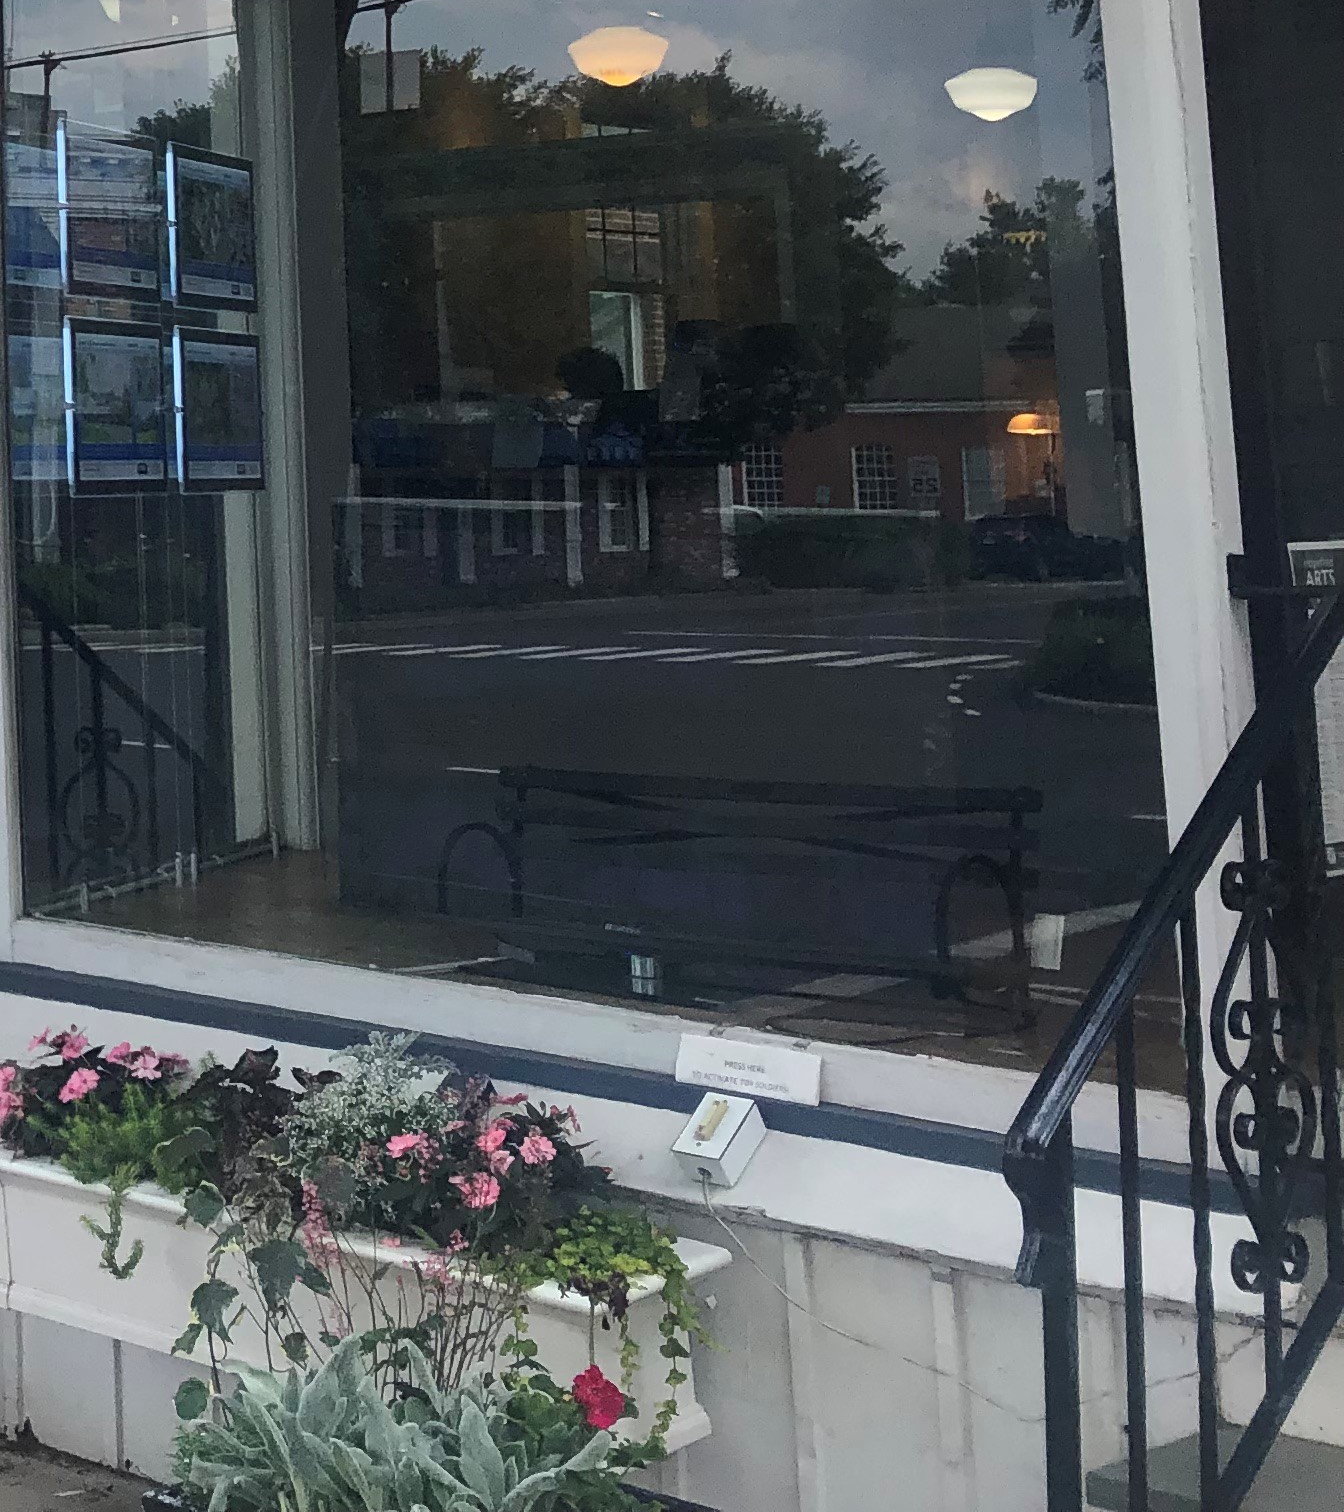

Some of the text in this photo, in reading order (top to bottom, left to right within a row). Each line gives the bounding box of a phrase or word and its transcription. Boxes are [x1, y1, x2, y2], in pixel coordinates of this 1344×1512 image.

[1306, 569, 1337, 586] ARTS
[724, 1060, 766, 1074] PRESS HERE
[692, 1070, 702, 1080] TO
[703, 1073, 738, 1086] ACTIVATE
